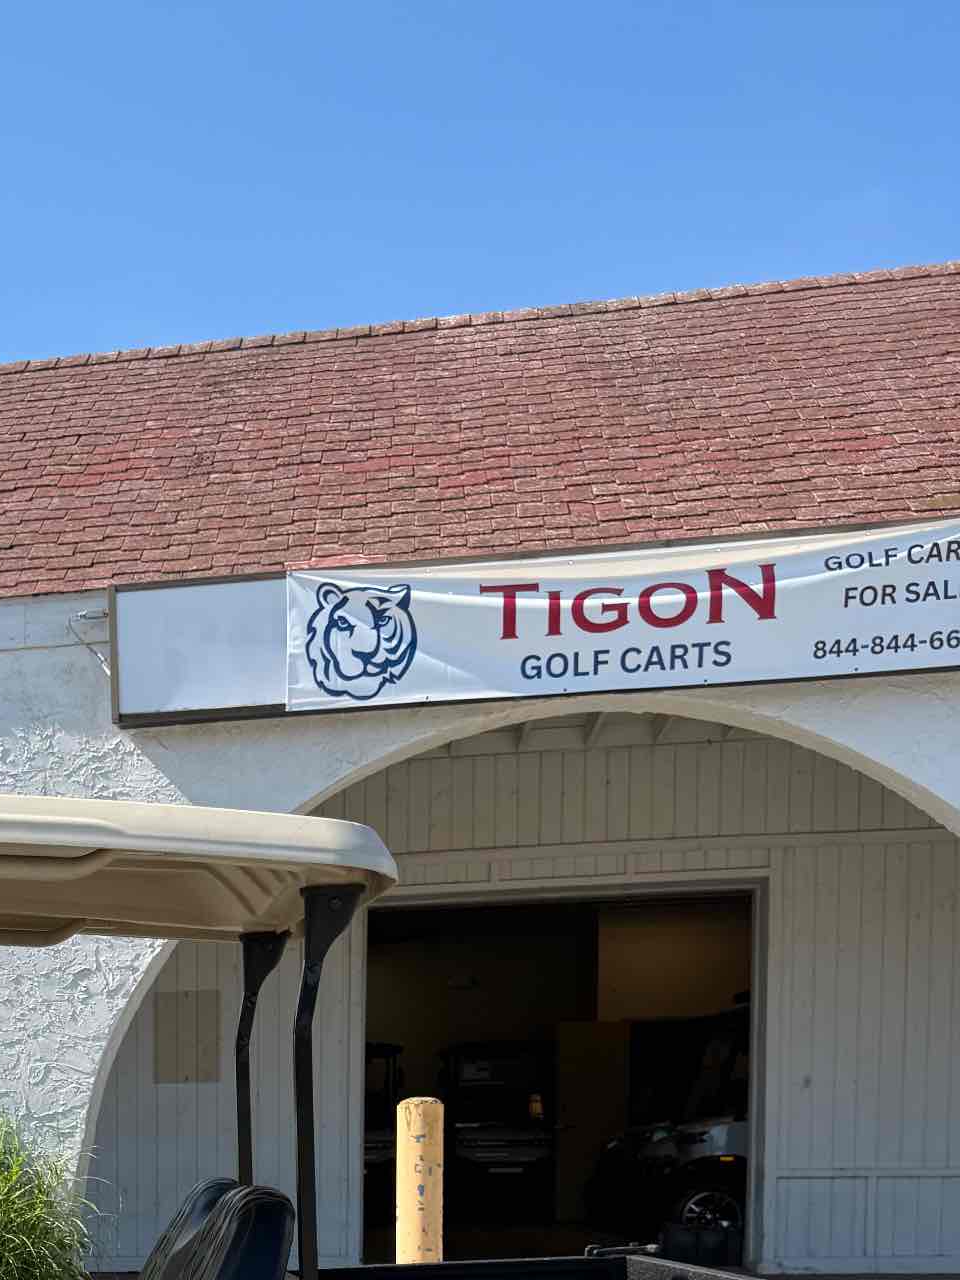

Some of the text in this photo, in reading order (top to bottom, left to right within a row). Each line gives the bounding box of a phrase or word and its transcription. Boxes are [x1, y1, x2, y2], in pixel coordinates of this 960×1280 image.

[824, 547, 898, 572] GOLF
[479, 563, 777, 640] TIGON
[843, 579, 960, 608] FOR SAL
[520, 640, 732, 680] GOLF CARTS
